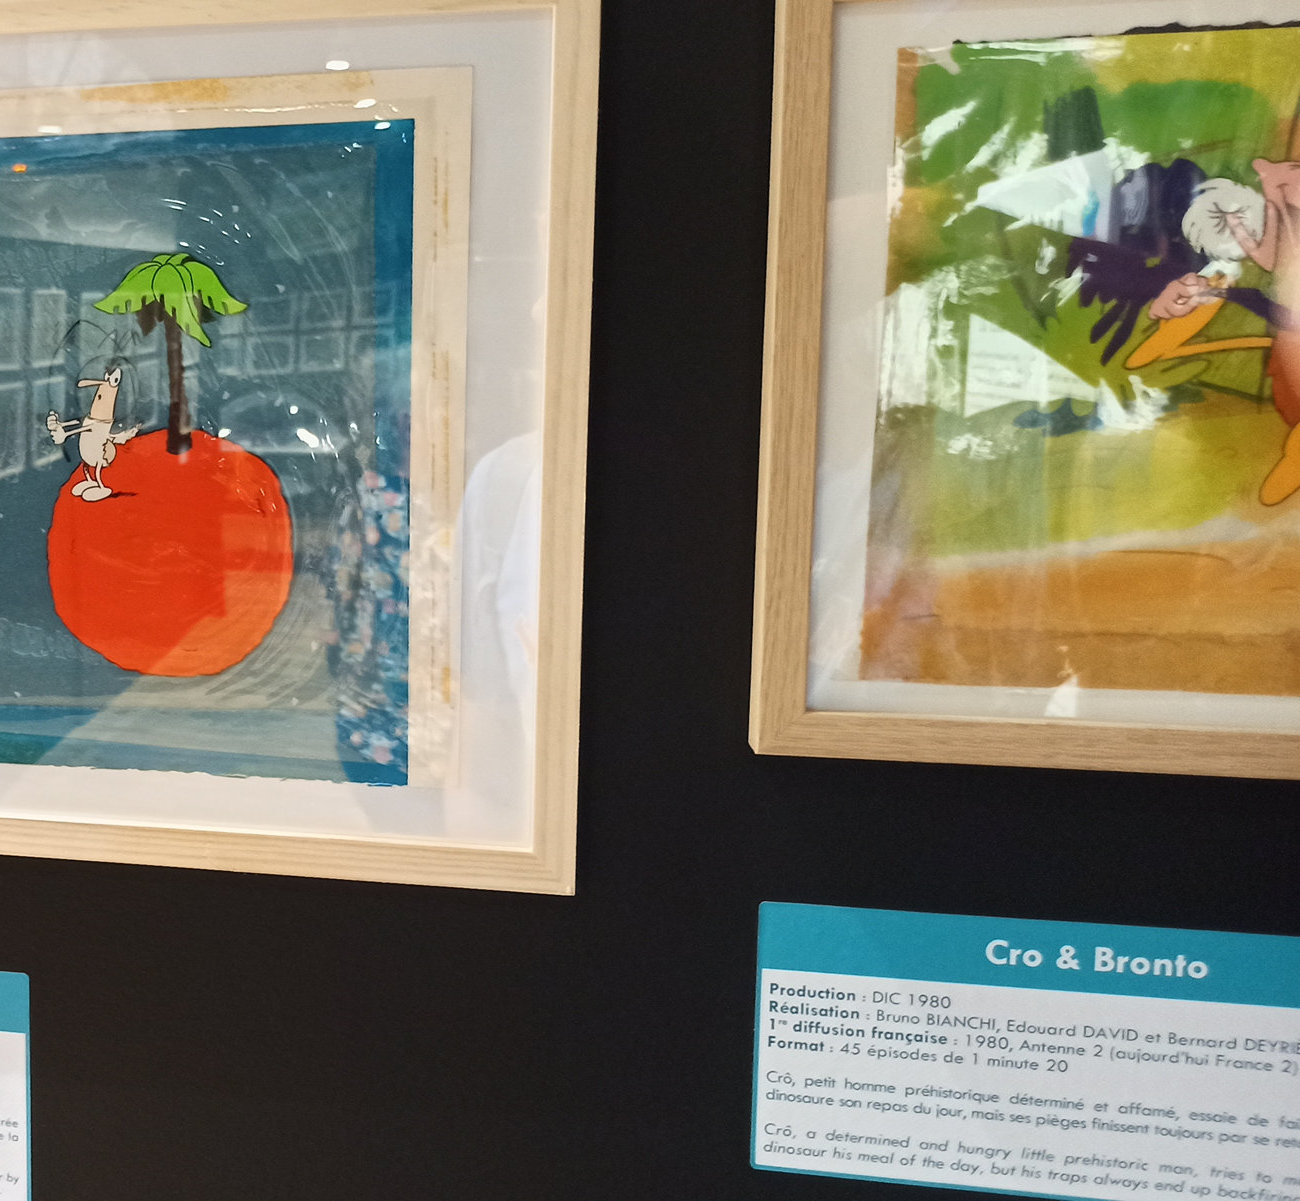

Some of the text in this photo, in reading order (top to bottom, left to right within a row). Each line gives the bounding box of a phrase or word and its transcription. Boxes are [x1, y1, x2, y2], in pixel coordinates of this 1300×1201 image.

[985, 939, 1209, 979] Cro & Bronto
[769, 982, 951, 1009] Production DIC 1980
[769, 1000, 859, 1019] Réalisation
[876, 1009, 920, 1024] Bruno
[926, 1013, 1000, 1033] BIANCHI,
[1006, 1019, 1076, 1037] Edouard
[1083, 1025, 1138, 1041] DAVID
[1144, 1033, 1161, 1043] et
[1168, 1032, 1237, 1050] Bernard
[792, 1020, 865, 1038] diffusion
[871, 1026, 947, 1045] française
[967, 1034, 1013, 1052] 1980,
[1019, 1039, 1086, 1056] Antenne
[1093, 1044, 1103, 1057] 2
[1110, 1047, 1208, 1066] (aujourd'hui
[1215, 1054, 1273, 1071] France
[1281, 1059, 1299, 1076] 2)
[767, 1035, 824, 1052] Format
[839, 1042, 860, 1055] 45
[867, 1044, 937, 1062] épisodes
[943, 1051, 964, 1064] de
[987, 1056, 1039, 1070] minute
[1046, 1058, 1068, 1073] 20
[765, 1088, 834, 1106] dinosaure
[839, 1098, 862, 1108] son
[866, 1101, 908, 1113] repas
[912, 1102, 931, 1115] du
[936, 1104, 967, 1120] jour,
[971, 1109, 1005, 1121] mais
[1009, 1113, 1031, 1124] ses
[1035, 1114, 1086, 1130] pièges
[1091, 1117, 1150, 1133] finissent
[1154, 1125, 1214, 1140] toujours
[1218, 1133, 1248, 1144] par
[1252, 1136, 1270, 1146] se
[766, 1070, 795, 1087] Crô,
[804, 1076, 836, 1088] petit
[844, 1077, 896, 1094] homme
[904, 1084, 999, 1104] préhistorique
[1009, 1093, 1084, 1110] déterminé
[1093, 1102, 1108, 1112] et
[1117, 1102, 1180, 1121] affamé,
[1188, 1111, 1237, 1124] essaie
[1247, 1114, 1269, 1127] de
[8, 1132, 19, 1142] la
[764, 1123, 796, 1139] Crô,
[806, 1130, 816, 1139] a
[825, 1129, 910, 1148] determined
[919, 1139, 949, 1152] and
[957, 1141, 1011, 1160] hungry
[1021, 1147, 1055, 1162] little
[1063, 1153, 1148, 1171] prehistoric
[1159, 1164, 1198, 1178] man,
[1210, 1167, 1245, 1181] tries
[1255, 1171, 1272, 1184] to
[6, 1173, 19, 1185] by
[763, 1140, 827, 1157] dinosaur
[832, 1146, 852, 1160] his
[857, 1152, 894, 1164] meal
[899, 1153, 916, 1166] of
[922, 1155, 944, 1169] the
[950, 1159, 983, 1175] day,
[990, 1162, 1016, 1176] but
[1021, 1165, 1041, 1179] his
[1048, 1170, 1087, 1184] traps
[1093, 1173, 1148, 1191] always
[1154, 1180, 1185, 1193] end
[1190, 1186, 1211, 1197] up
